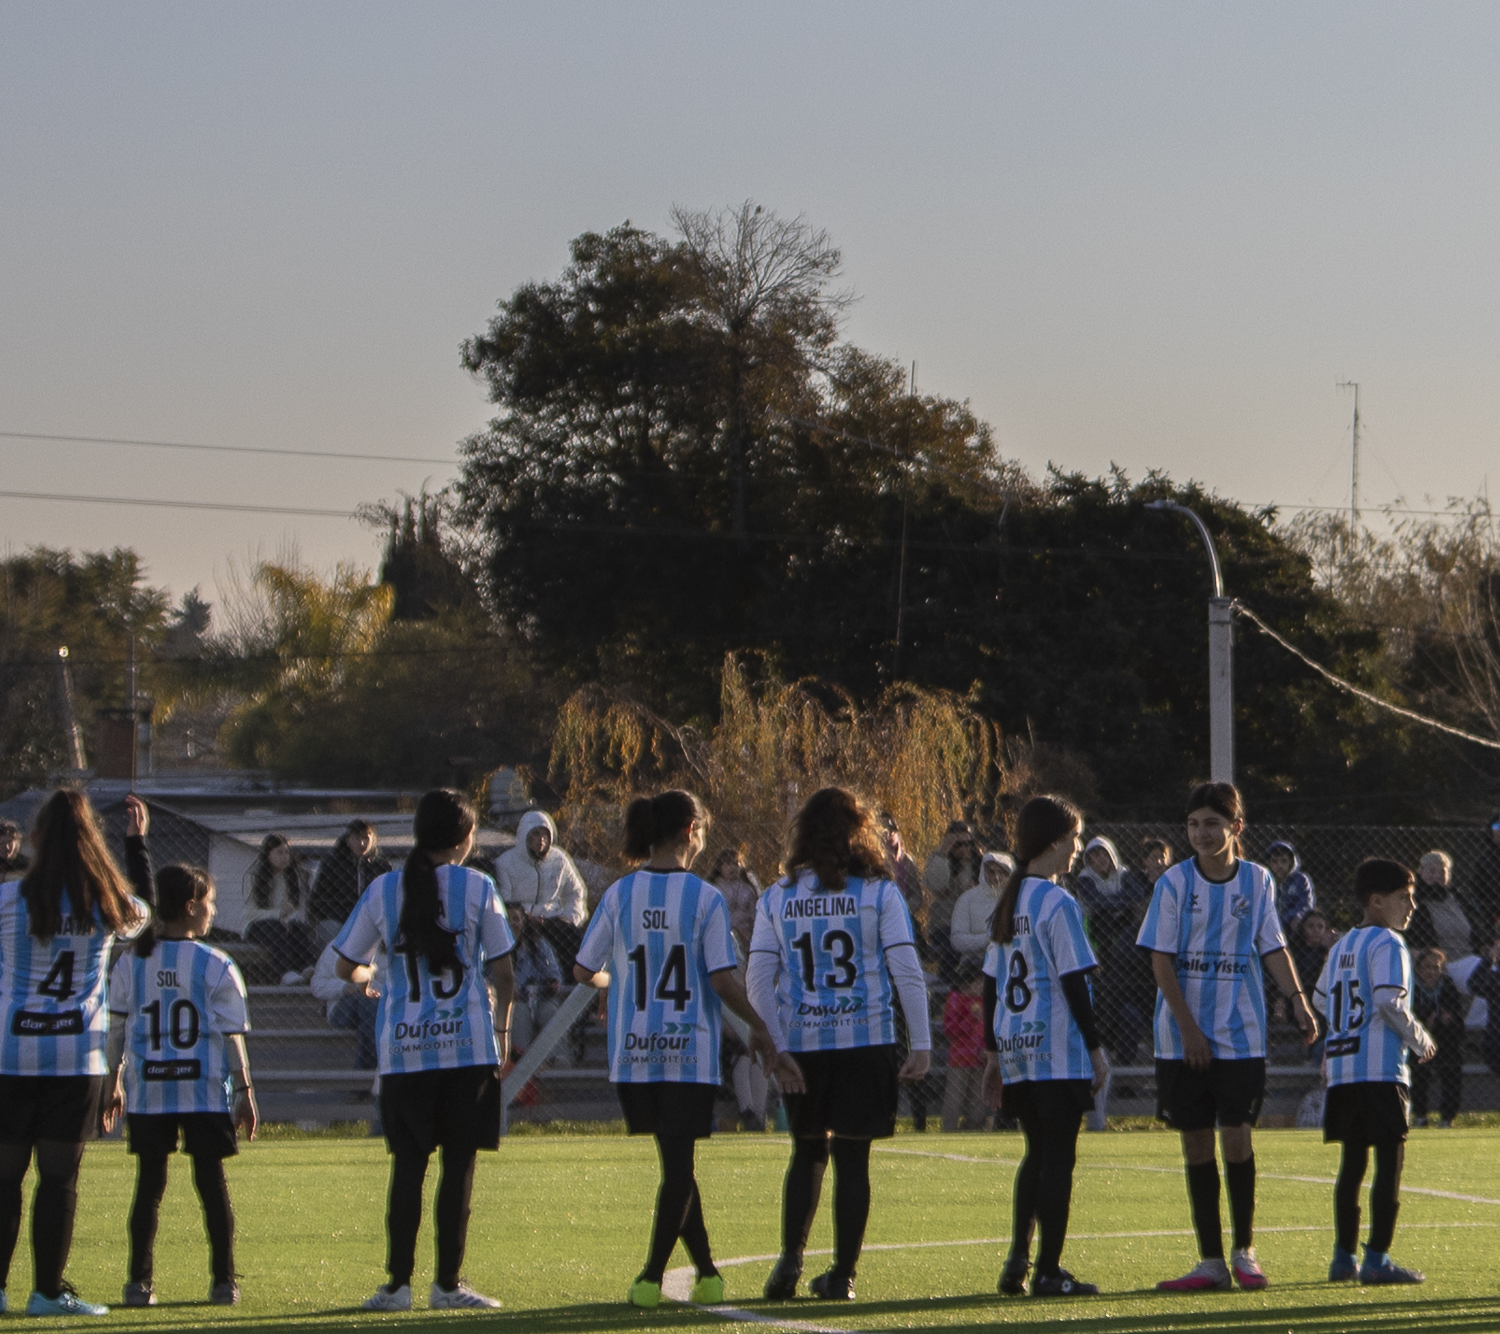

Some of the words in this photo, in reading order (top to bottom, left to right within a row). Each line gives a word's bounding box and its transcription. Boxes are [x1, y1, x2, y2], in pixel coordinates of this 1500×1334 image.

[784, 897, 856, 919] ANGELINA
[642, 910, 669, 930] SOL
[791, 929, 857, 992] 13
[37, 951, 76, 1002] 4
[156, 971, 180, 987] SOL
[628, 944, 691, 1012] 14
[1005, 950, 1031, 1014] 8
[1330, 979, 1365, 1033] 15
[141, 998, 199, 1051] 10
[395, 1020, 463, 1040] Dufour
[788, 1017, 869, 1029] COMMODITIES
[388, 1037, 474, 1055] COMMODITIES
[624, 1032, 690, 1053] Dufour
[997, 1033, 1045, 1053] Dufour
[617, 1055, 698, 1065] COMMODITIES
